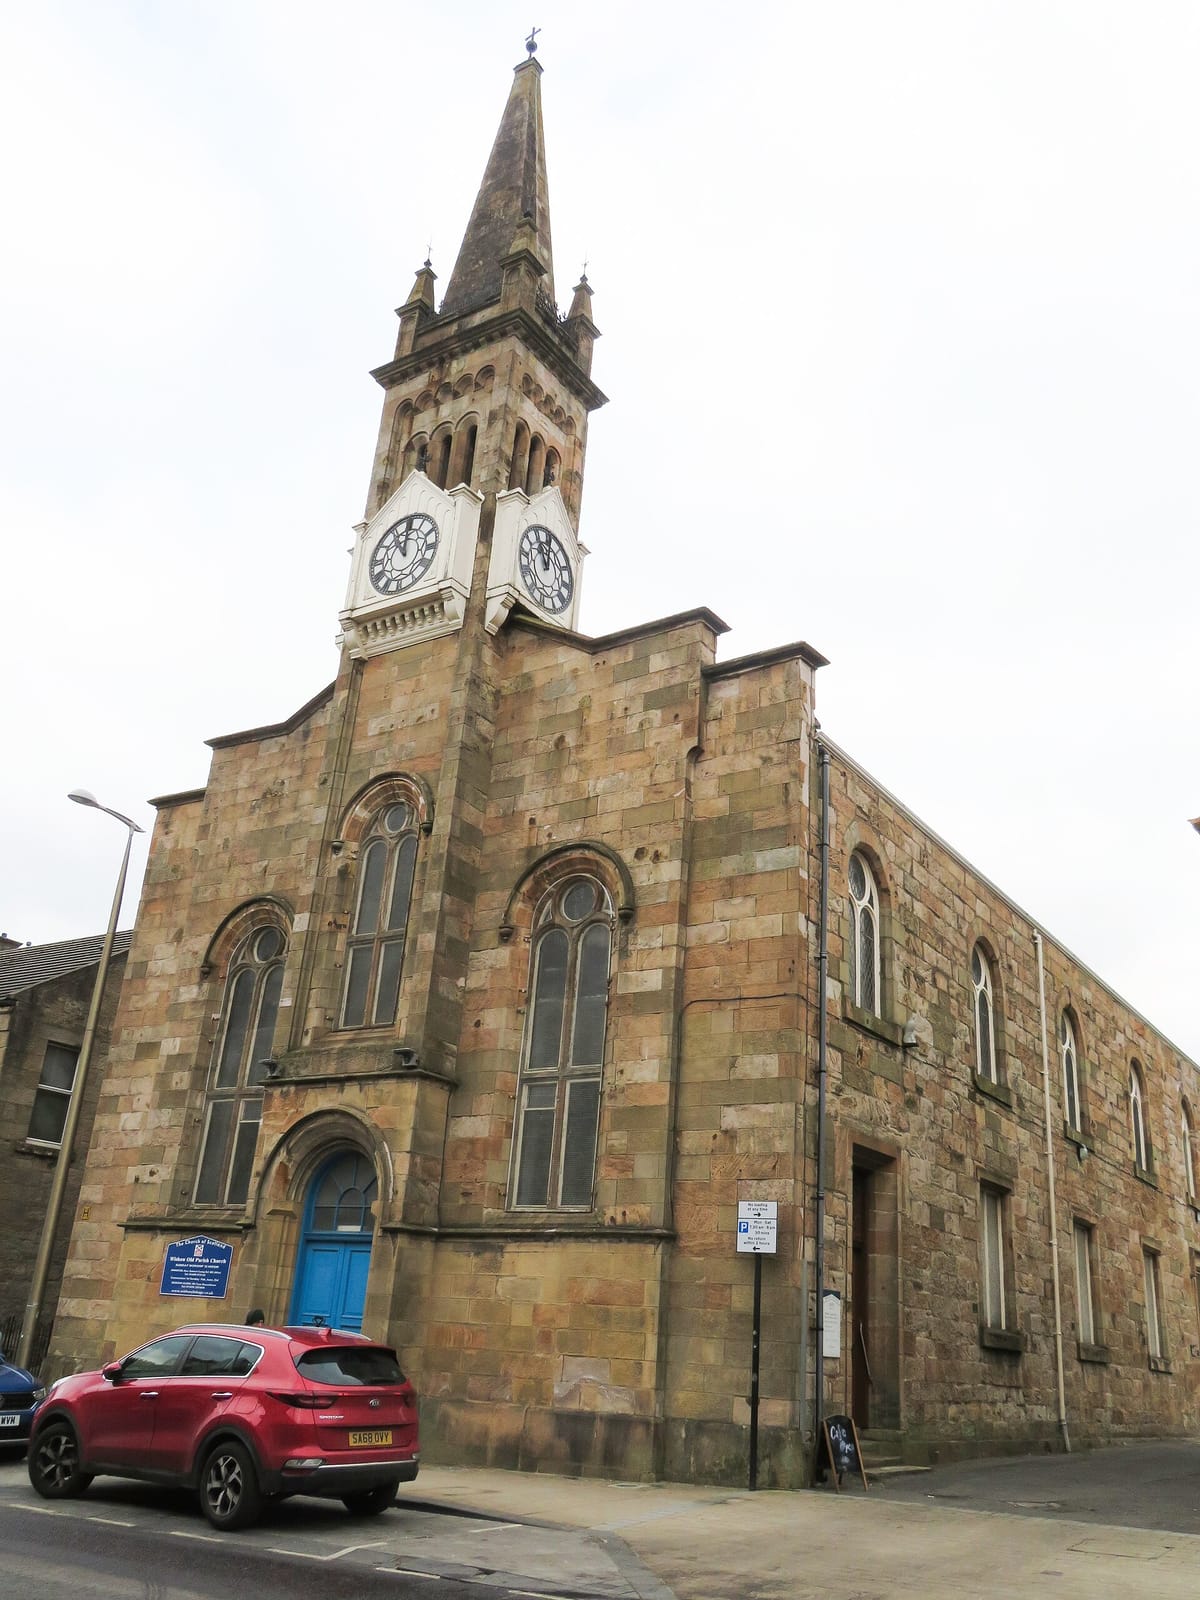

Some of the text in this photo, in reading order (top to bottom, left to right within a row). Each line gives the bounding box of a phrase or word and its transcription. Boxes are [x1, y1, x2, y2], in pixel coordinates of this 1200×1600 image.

[740, 1222, 748, 1232] P
[207, 1240, 226, 1249] Scotland
[352, 1433, 373, 1444] SA68
